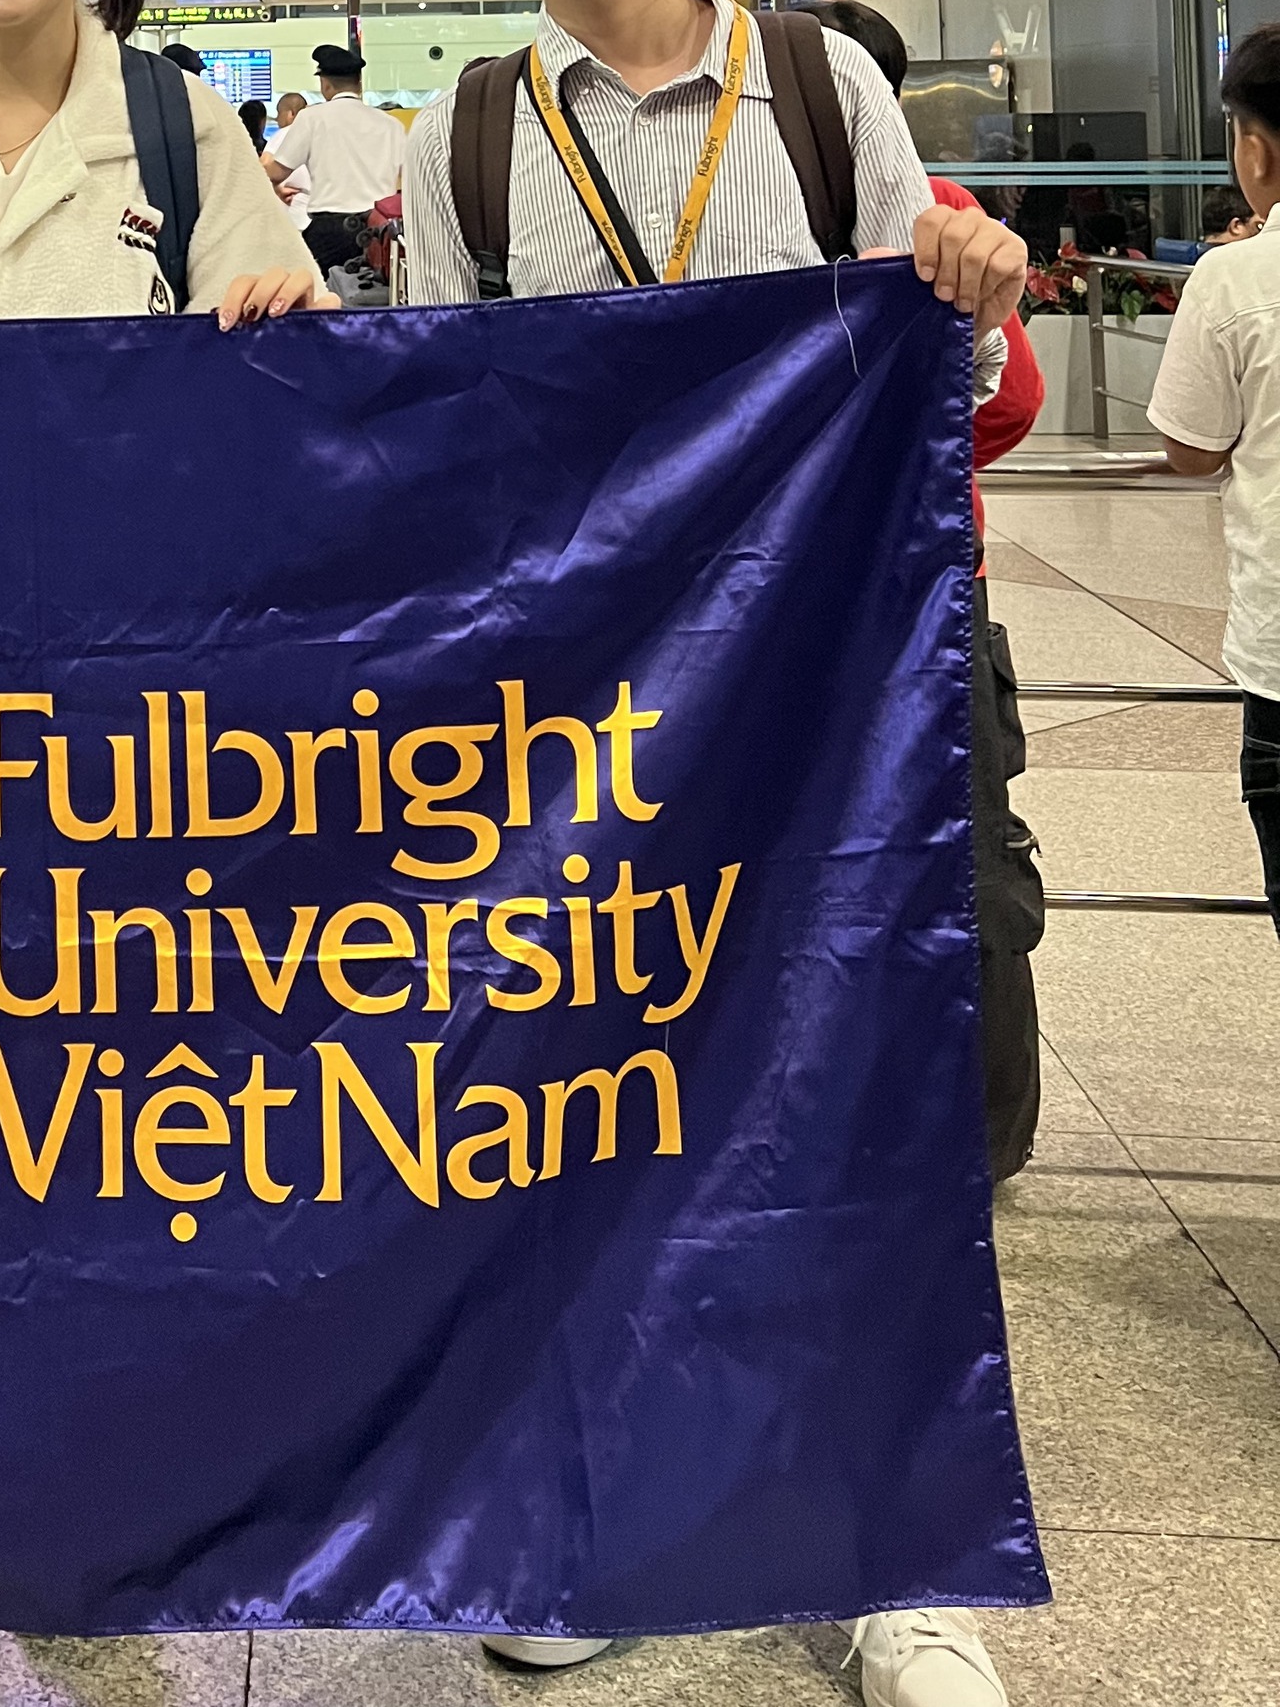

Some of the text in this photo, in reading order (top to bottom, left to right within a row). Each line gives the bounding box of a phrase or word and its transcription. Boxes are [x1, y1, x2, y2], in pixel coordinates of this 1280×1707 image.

[724, 56, 741, 97] Fulbright
[563, 144, 587, 183] Fulbright
[697, 136, 720, 177] Fulbright
[672, 218, 694, 261] Fulbright
[310, 1040, 683, 1210] Nam
